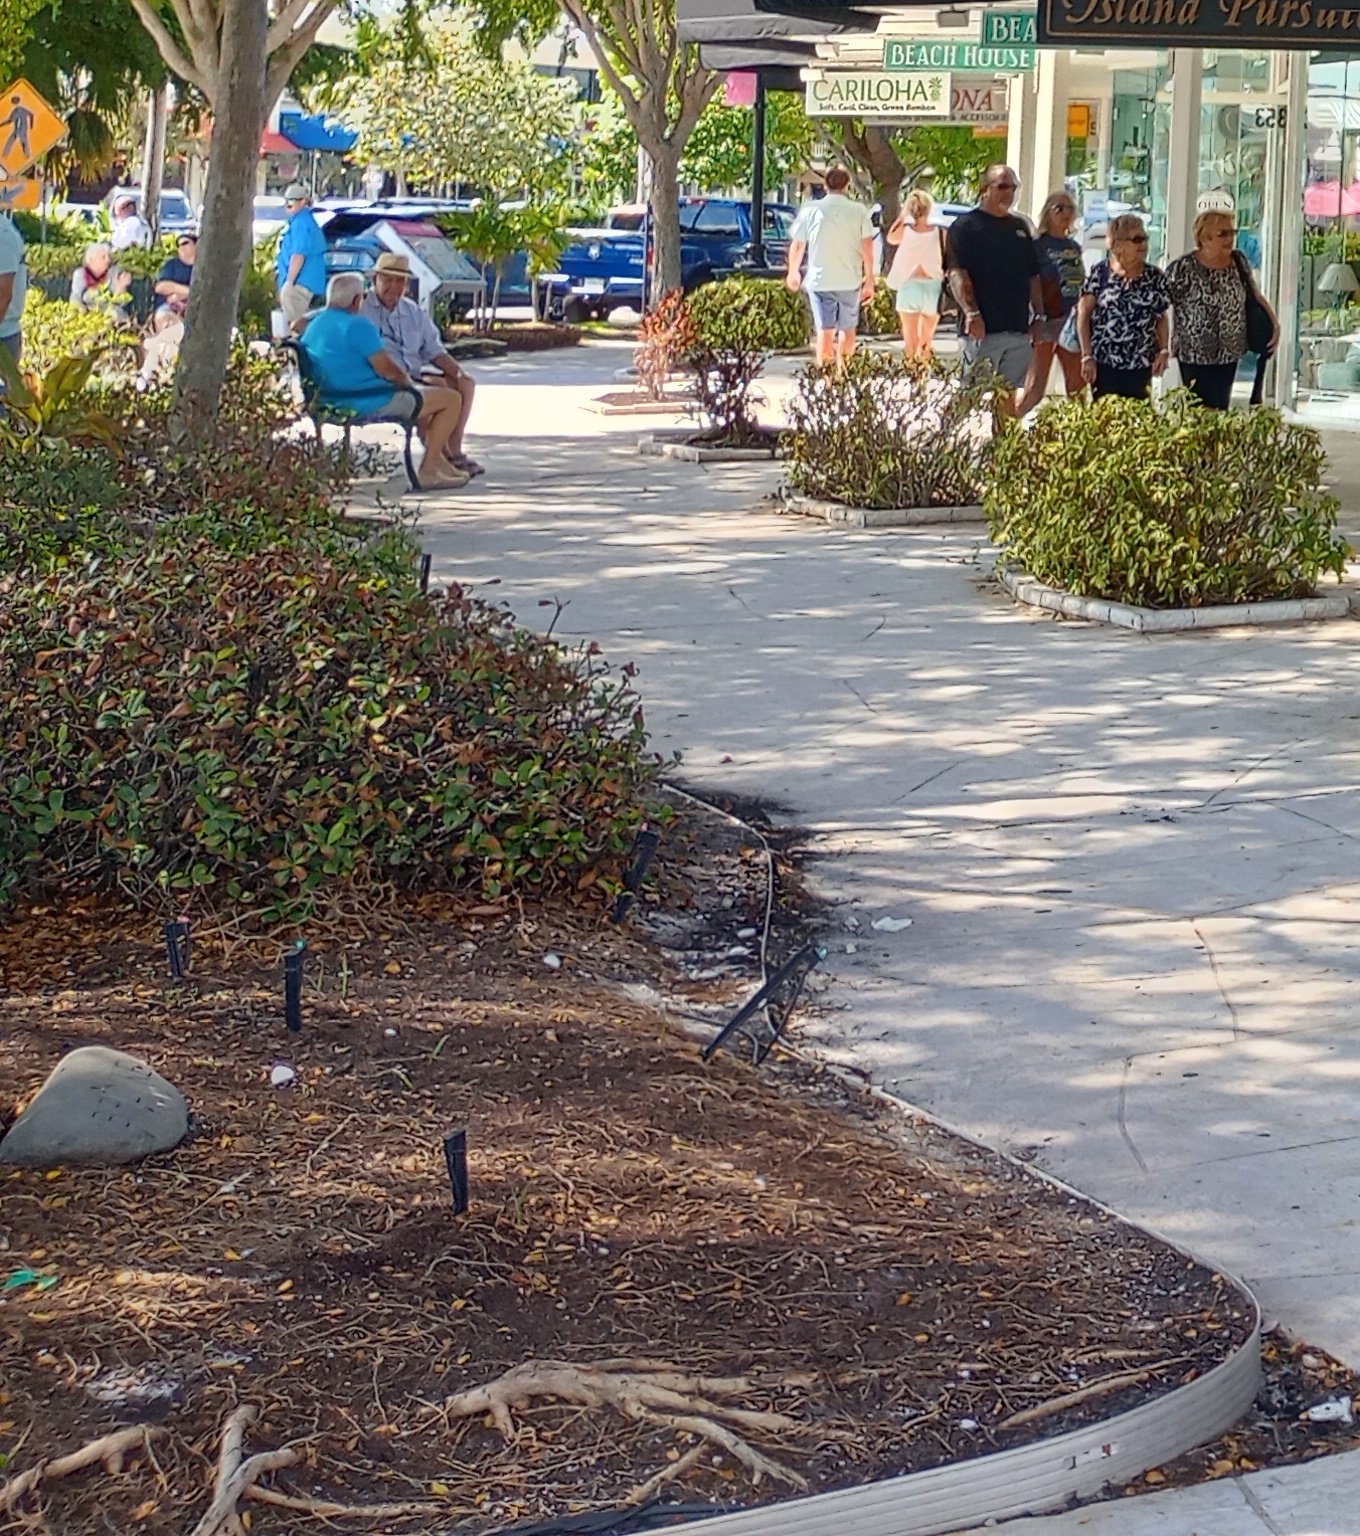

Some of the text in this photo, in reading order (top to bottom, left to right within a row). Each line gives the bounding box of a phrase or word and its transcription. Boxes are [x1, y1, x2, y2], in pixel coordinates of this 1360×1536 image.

[890, 45, 1029, 67] BEACH HOUSE
[812, 79, 928, 102] CARILOHA
[1198, 201, 1232, 210] OPEN
